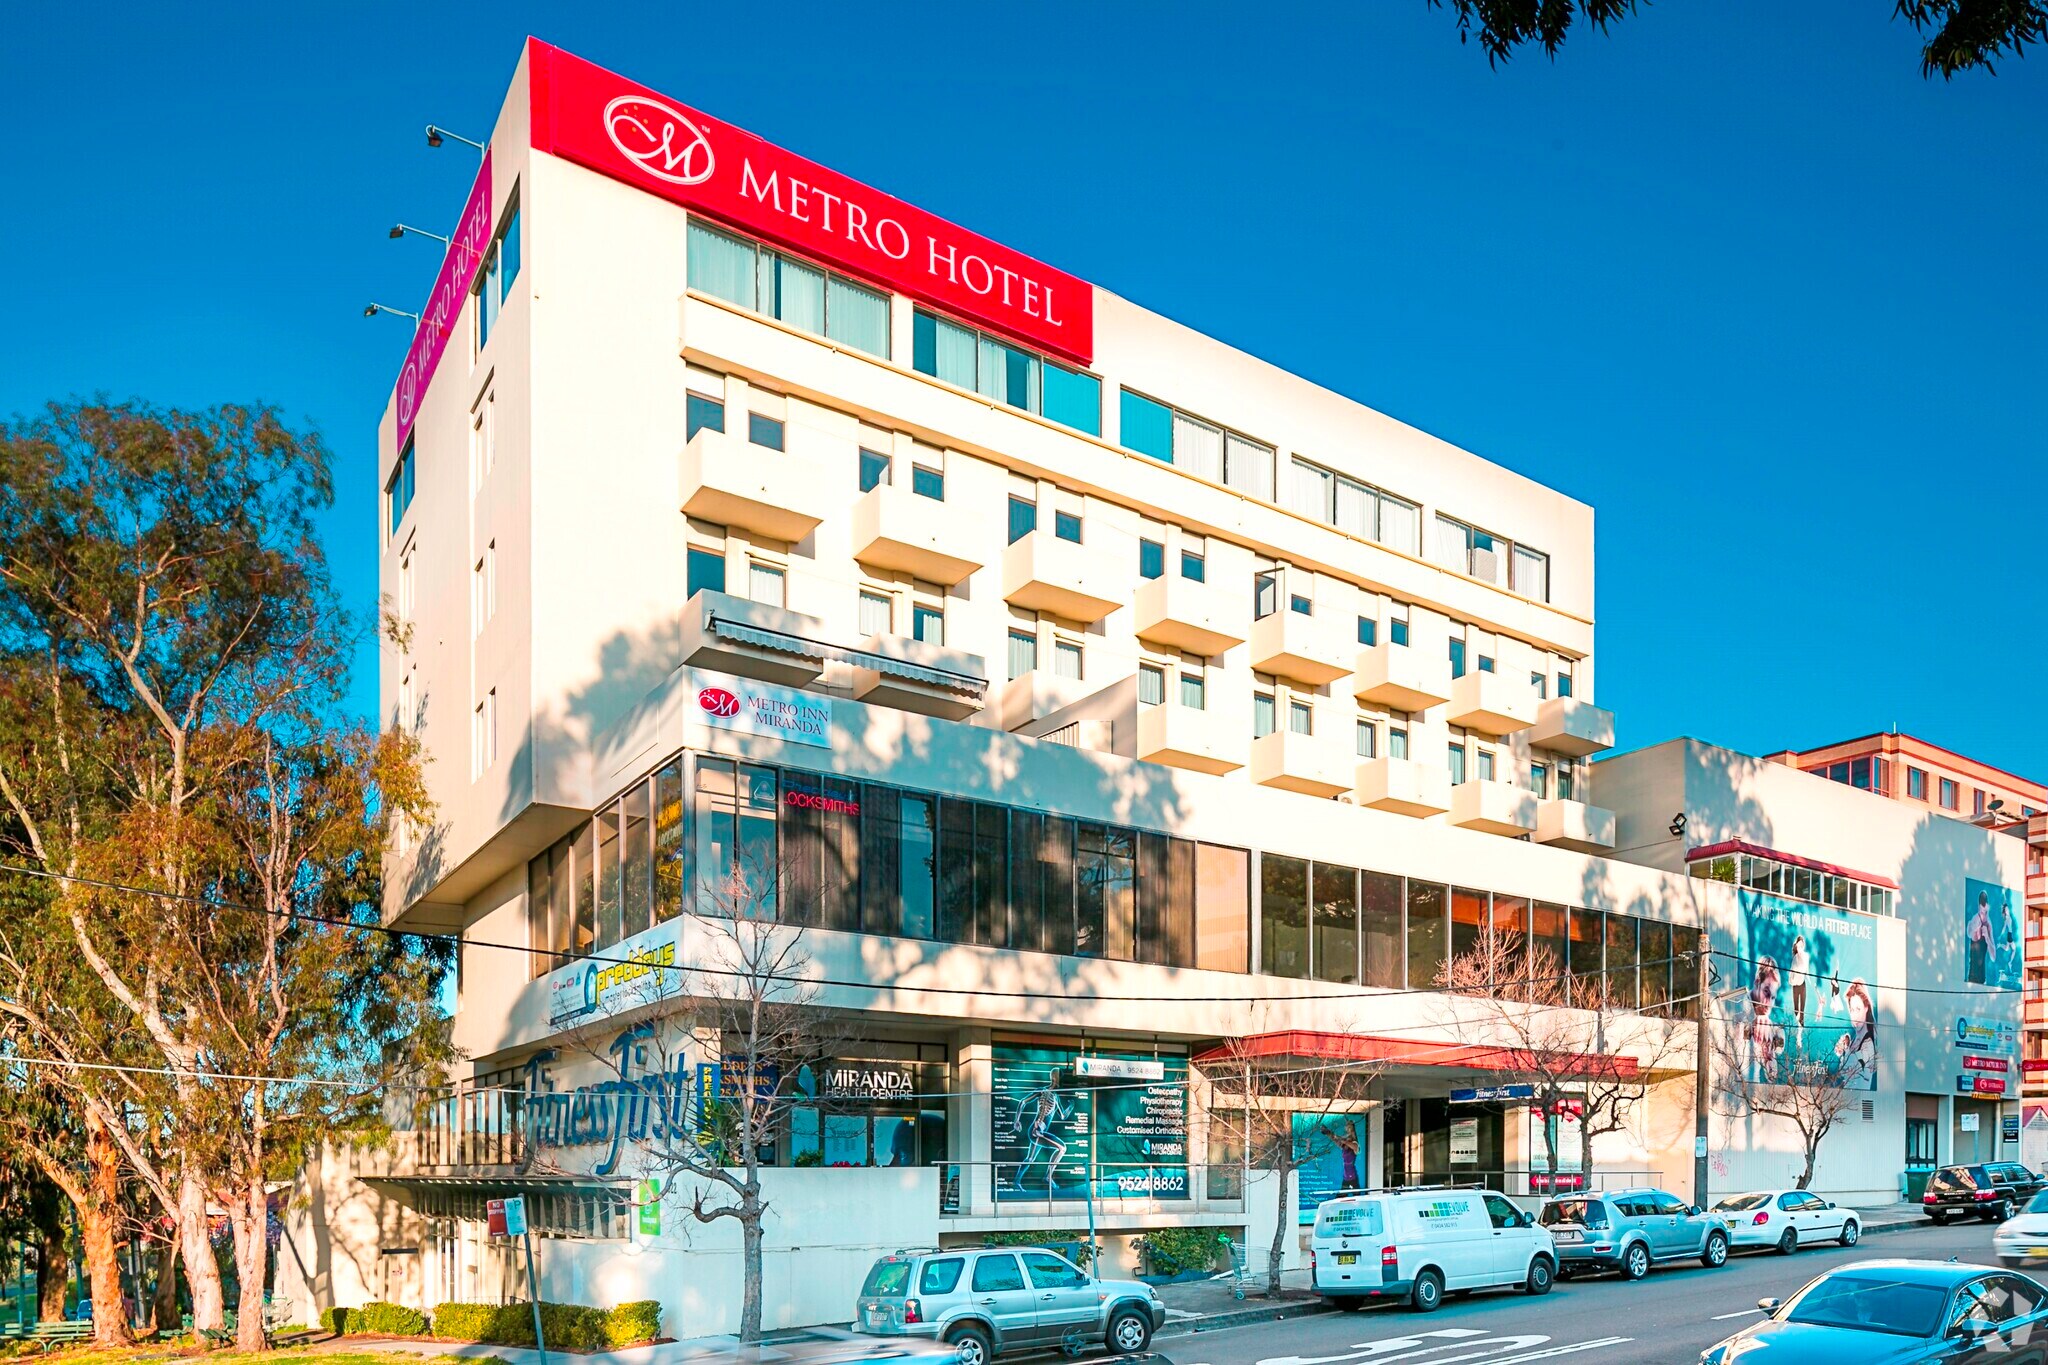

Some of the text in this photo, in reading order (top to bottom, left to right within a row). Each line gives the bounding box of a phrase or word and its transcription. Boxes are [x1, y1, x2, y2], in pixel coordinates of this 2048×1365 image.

[738, 156, 1064, 328] METRO HOTEL
[418, 189, 488, 381] METRO HOTEL
[747, 695, 829, 723] METRO INN
[754, 711, 822, 735] MIRANDA
[1775, 908, 1790, 925] THE
[1791, 910, 1818, 930] WORLD
[1818, 917, 1825, 930] A
[1825, 918, 1850, 936] FITTER
[1850, 922, 1873, 941] PLACE
[1089, 1063, 1122, 1073] MIRANDA
[1971, 1059, 1986, 1067] METRO
[825, 1069, 914, 1090] MIRANDA
[825, 1087, 914, 1101] HEALTH CENTRE
[1147, 1087, 1184, 1097] Osteopathy
[1140, 1096, 1184, 1107] Physiotherapy
[1146, 1107, 1183, 1116] Chiropractic
[1125, 1116, 1183, 1127] Remedial Massage
[1116, 1125, 1183, 1135] Customised Orthotics
[1151, 1143, 1182, 1152] MIRANDA
[1117, 1176, 1184, 1191] 9524 8862
[1450, 1200, 1471, 1212] EVOLVE
[1352, 1207, 1374, 1218] EVOLVE
